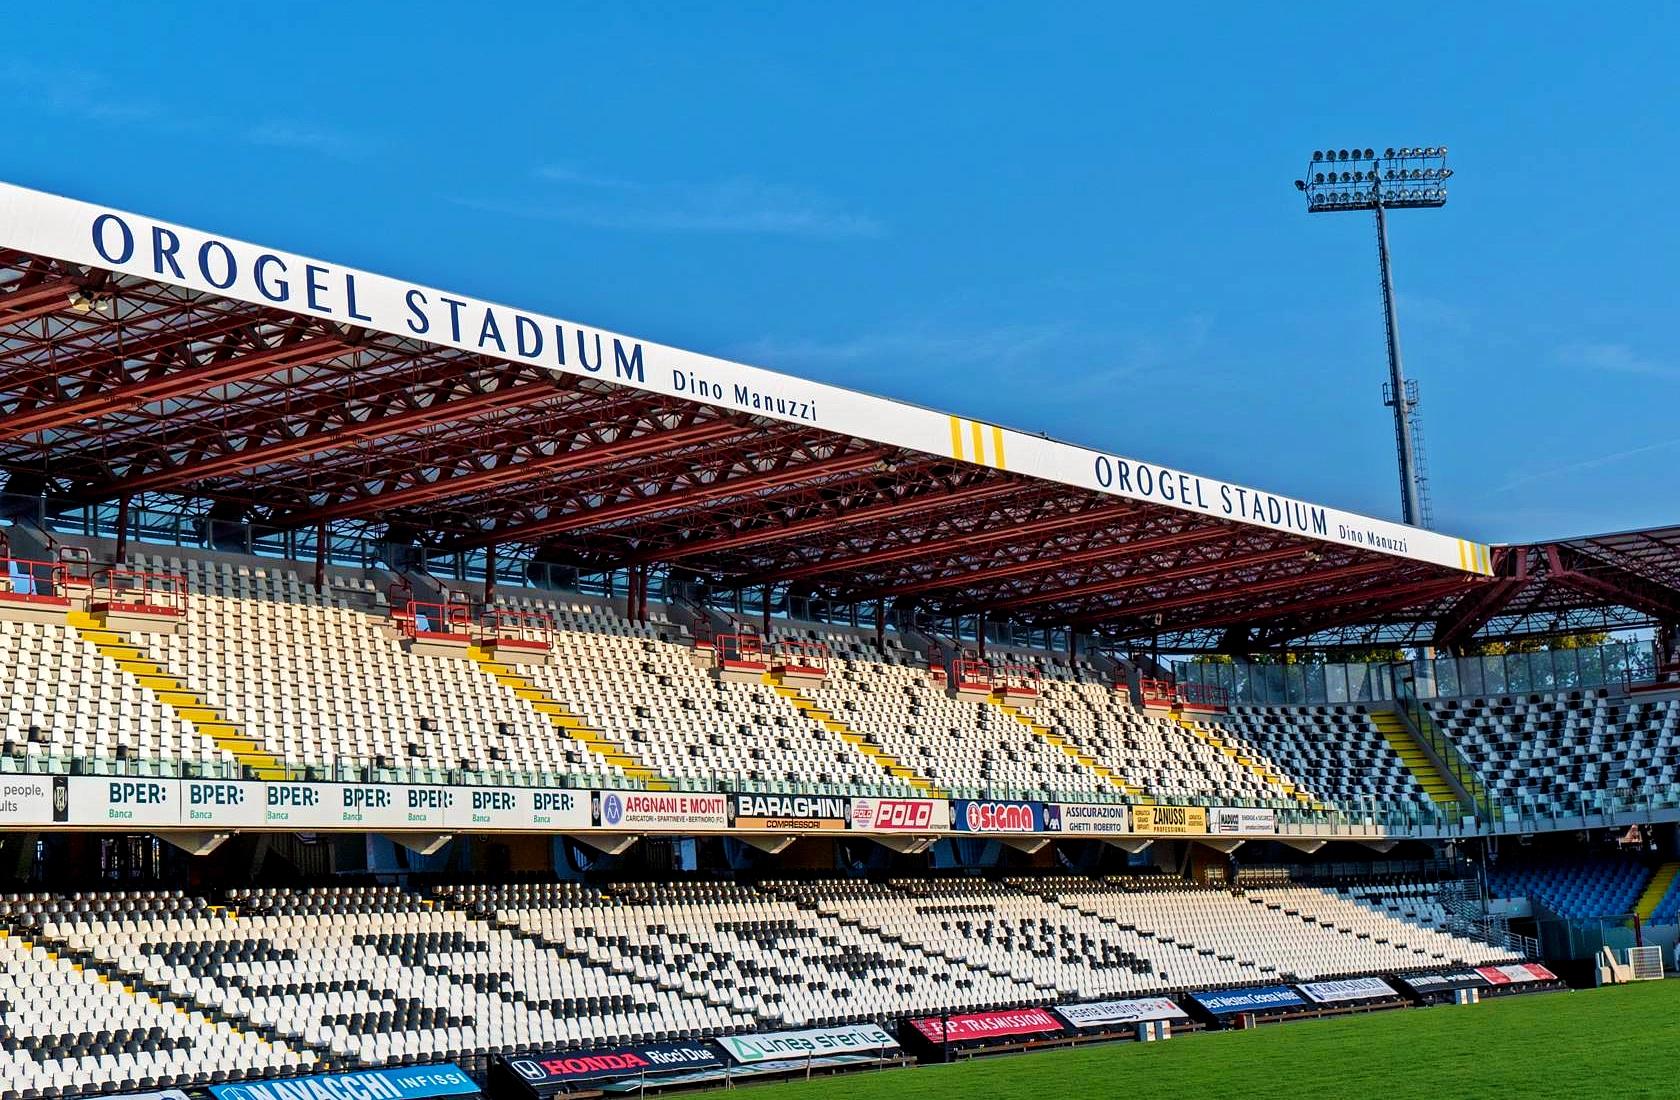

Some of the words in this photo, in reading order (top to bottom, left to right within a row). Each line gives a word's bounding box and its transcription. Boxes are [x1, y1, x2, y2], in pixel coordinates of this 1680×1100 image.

[92, 213, 371, 322] OROGEL
[405, 289, 645, 383] STADIUM
[673, 370, 722, 400] Dino
[734, 384, 817, 421] Manuzzi
[1095, 456, 1208, 508] OROGEL
[1221, 485, 1327, 535] STADIUM
[1339, 525, 1363, 544] Dino
[1368, 532, 1408, 553] Manuzzi
[4, 784, 44, 797] people,
[626, 797, 677, 813] ARGNANI
[681, 798, 686, 813] E
[690, 798, 724, 814] MONTI
[739, 796, 844, 817] BARAGHINI
[109, 809, 133, 818] Banca
[190, 810, 213, 819] Banca
[267, 811, 289, 820] Banca
[343, 812, 362, 821] Banca
[408, 813, 427, 822] Banca
[473, 814, 491, 823] Banca
[876, 803, 931, 826] POLO
[1066, 807, 1123, 818] ASSICURAZIONI
[1153, 807, 1186, 825] ZANUSSI
[534, 815, 551, 824] Banca
[766, 820, 820, 828] COMPRESSORI
[1070, 823, 1090, 831] GHETTI
[1094, 823, 1121, 831] ROBERTO
[964, 1014, 1052, 1033] TRASMISSIONI
[757, 1036, 815, 1053] Linea
[818, 1029, 888, 1049] sterile
[545, 1053, 650, 1075] HONDA
[645, 1049, 684, 1065] Ricci
[682, 1048, 715, 1061] Due
[245, 1073, 402, 1100] NAVACCHI
[396, 1073, 467, 1089] INFISSI
